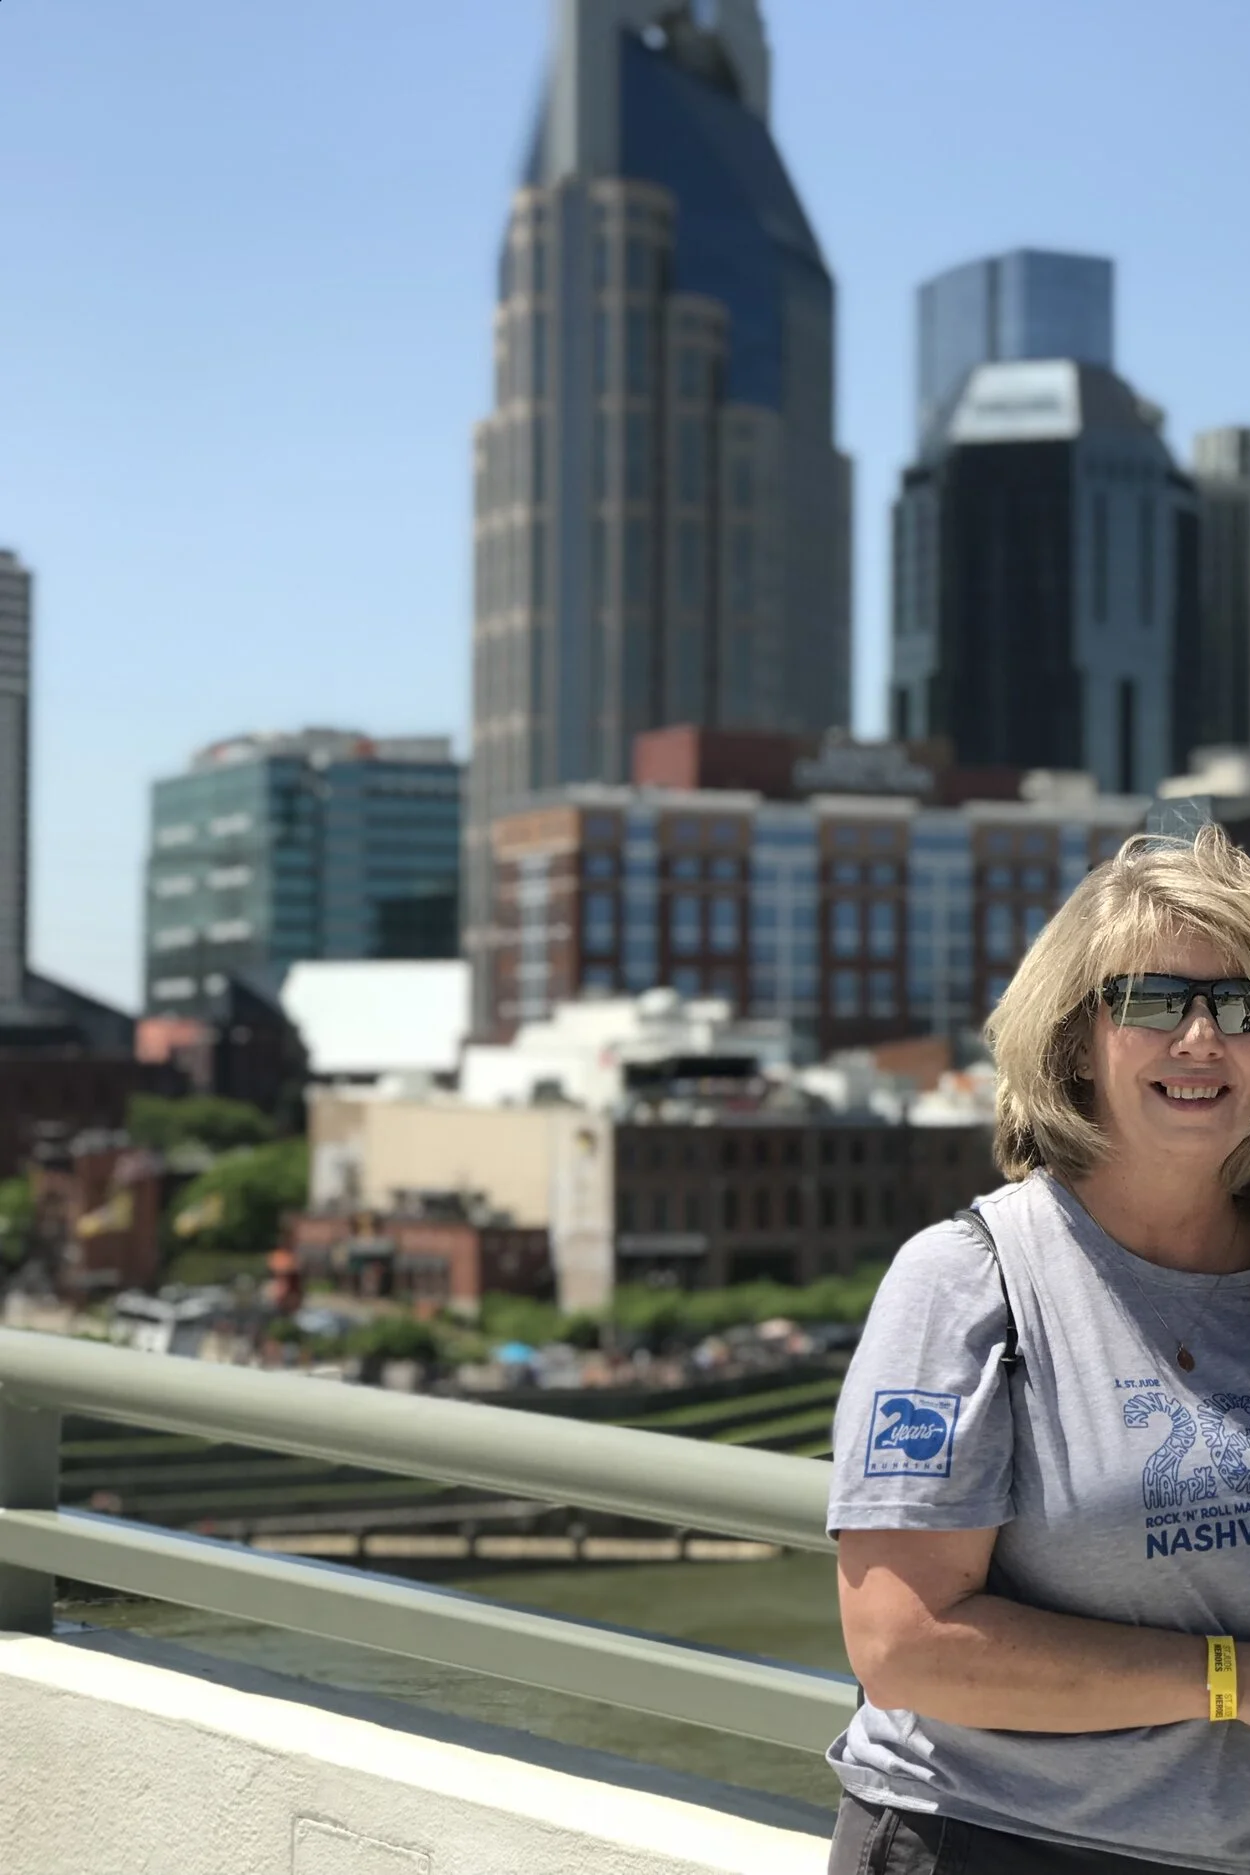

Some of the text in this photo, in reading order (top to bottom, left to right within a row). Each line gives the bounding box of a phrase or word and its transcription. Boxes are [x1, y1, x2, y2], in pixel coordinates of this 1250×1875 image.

[1139, 1379, 1160, 1388] JUDE
[882, 1423, 944, 1447] years
[1146, 1512, 1181, 1528] ROCK
[1200, 1505, 1232, 1519] ROLL
